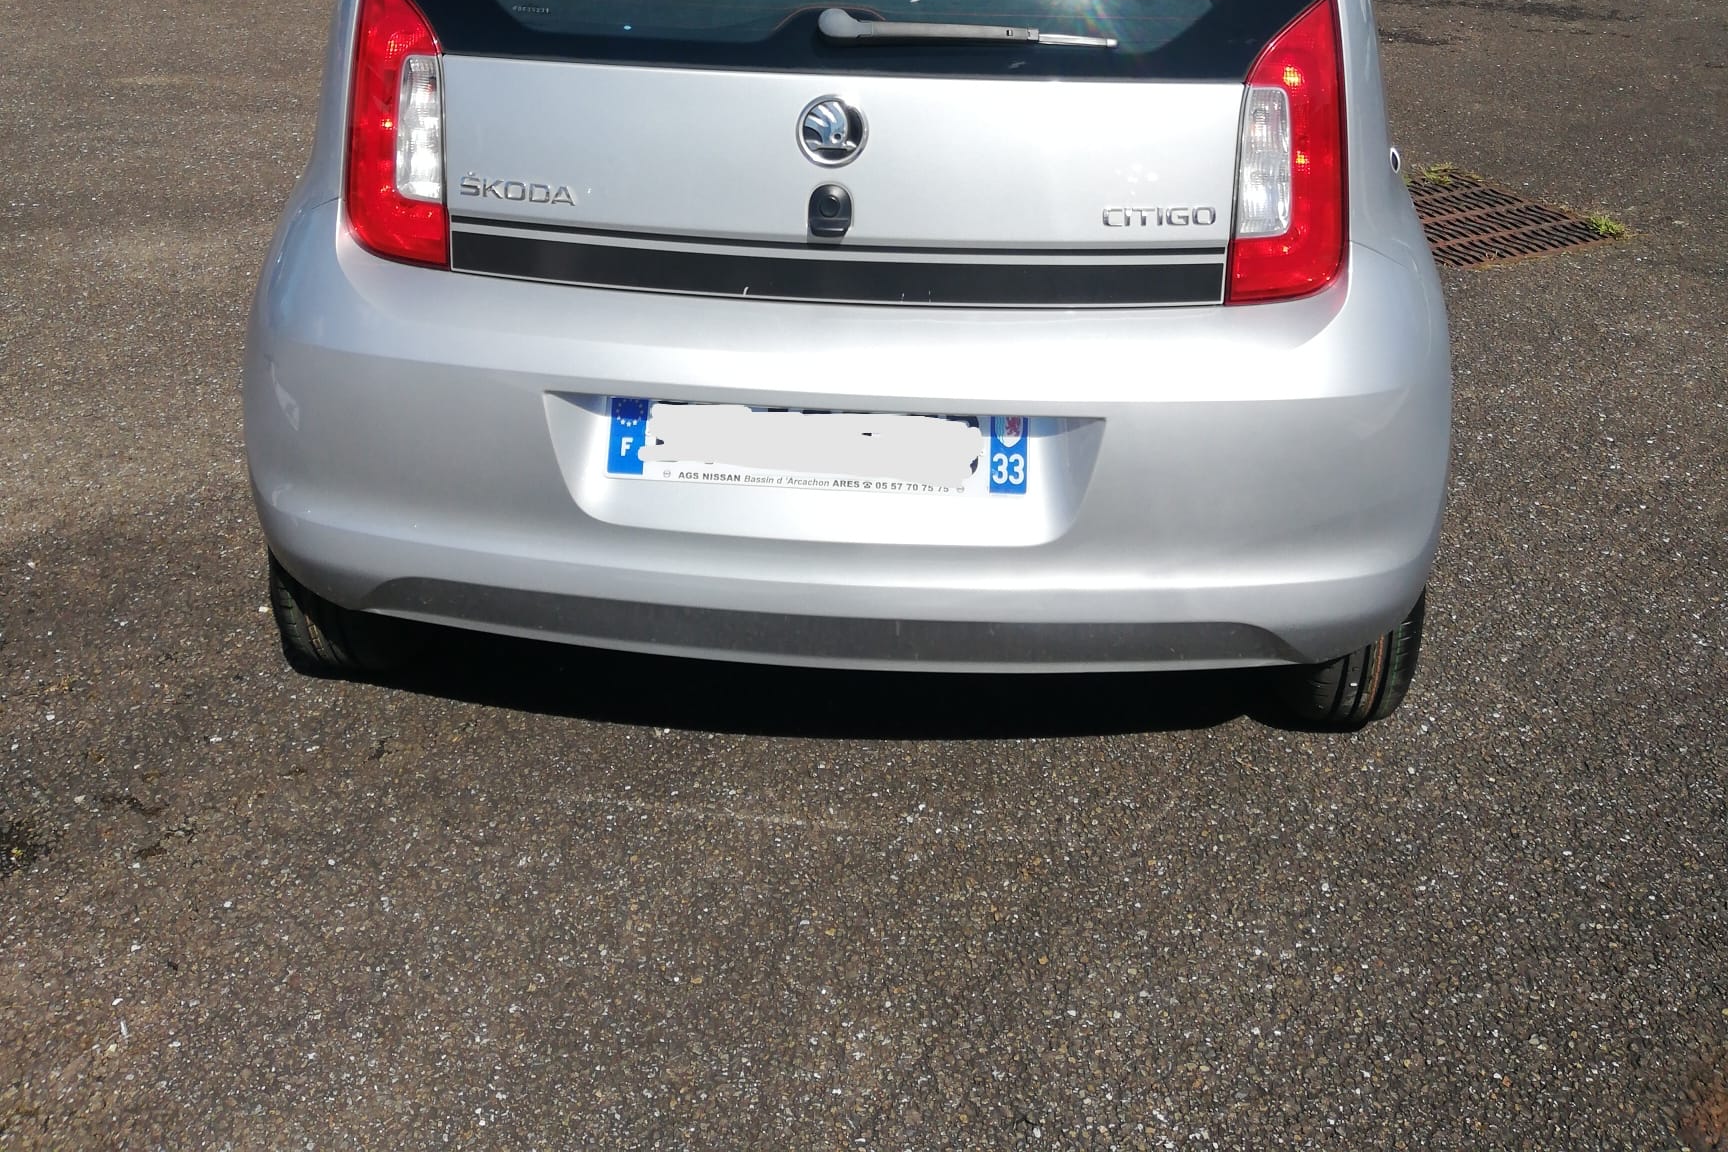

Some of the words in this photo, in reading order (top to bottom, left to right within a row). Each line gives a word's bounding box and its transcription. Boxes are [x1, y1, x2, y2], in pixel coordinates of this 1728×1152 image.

[460, 171, 576, 206] ŠKODA
[1102, 207, 1217, 227] CITIGO
[620, 436, 634, 457] F
[992, 452, 1025, 485] 33
[678, 471, 699, 480] AGS
[702, 473, 741, 482] NISSAN
[744, 474, 774, 484] Bassin
[832, 479, 860, 489] ARES
[875, 481, 888, 490] 05
[890, 482, 903, 491] 57
[906, 483, 919, 492] 70
[921, 484, 934, 493] 75
